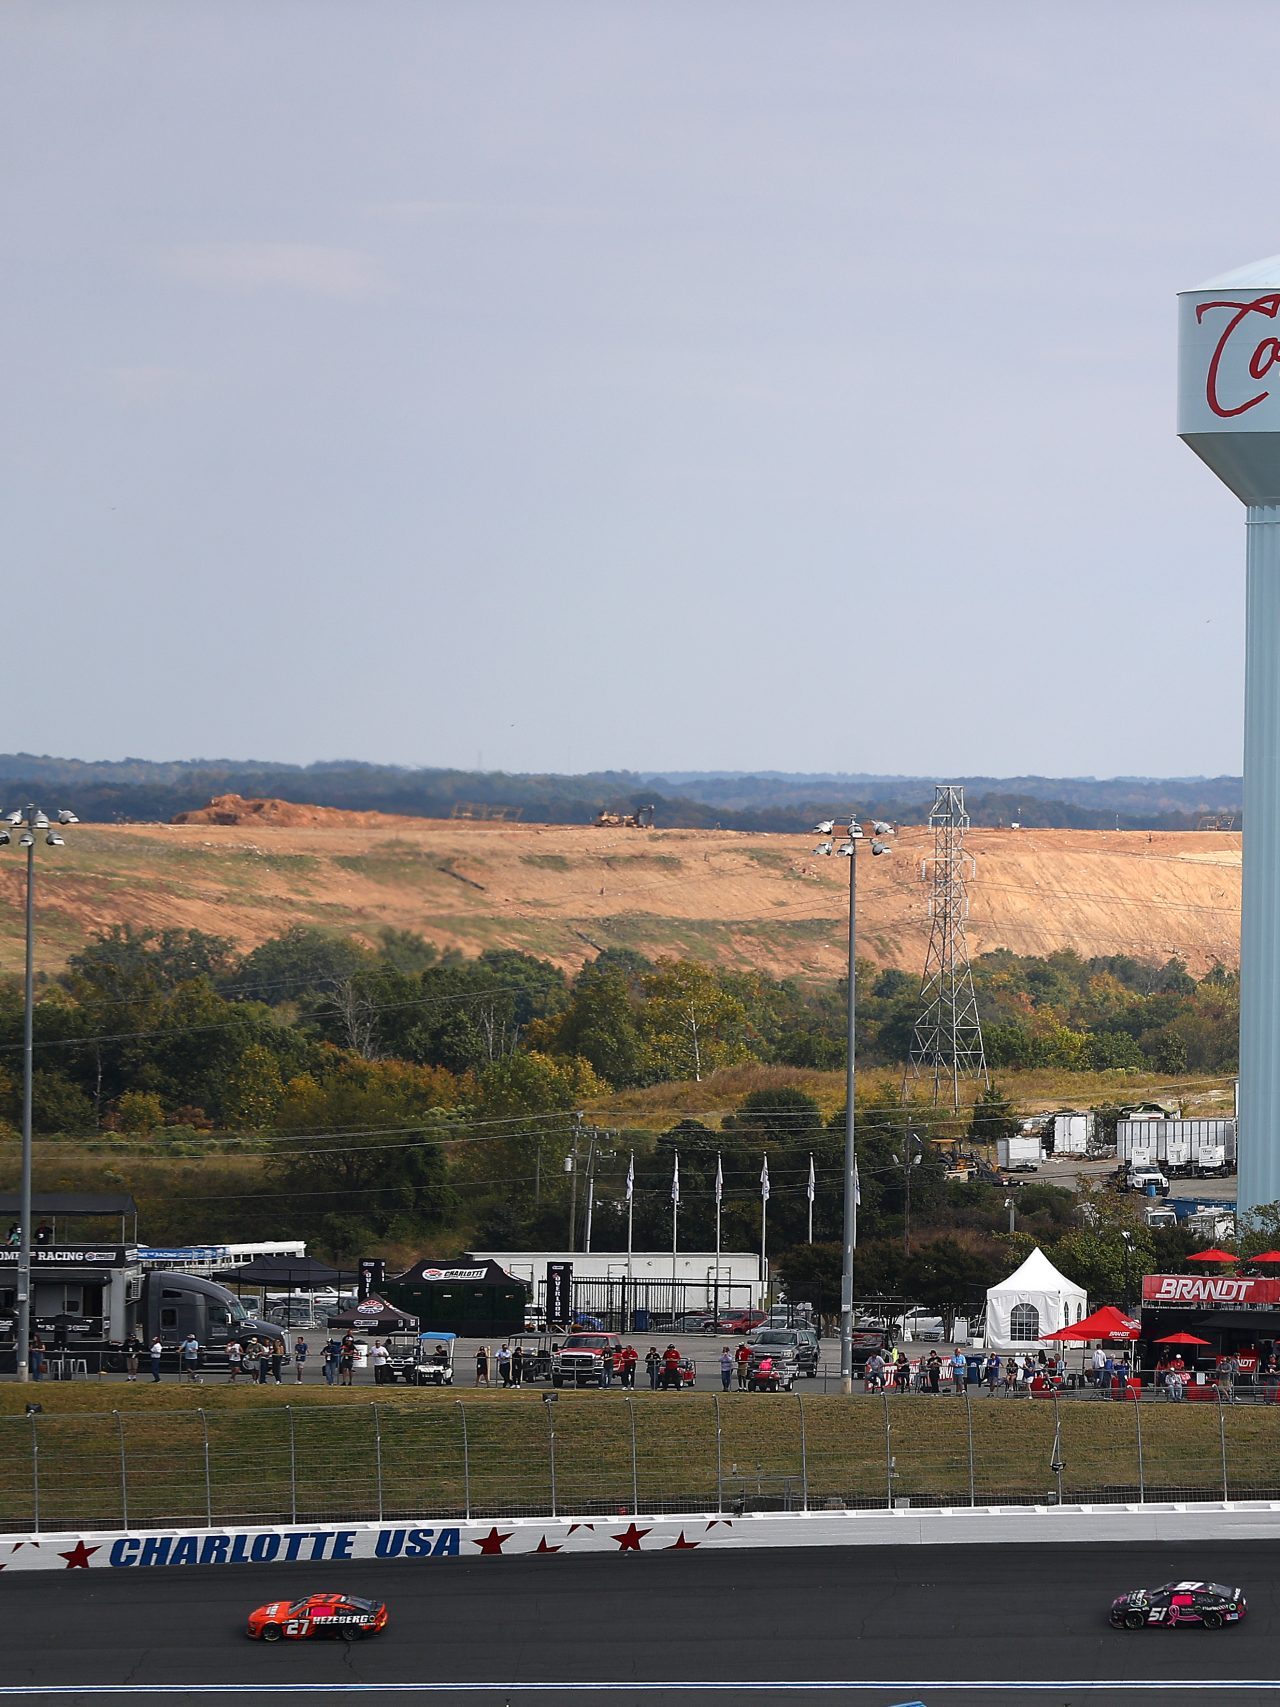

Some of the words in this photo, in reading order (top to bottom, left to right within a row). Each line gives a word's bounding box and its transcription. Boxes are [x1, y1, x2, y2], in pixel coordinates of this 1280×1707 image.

[37, 1251, 83, 1260] RACING
[1155, 1279, 1255, 1300] BRANDT
[109, 1530, 357, 1567] CHARLOTTE
[374, 1528, 460, 1558] USA
[1173, 1581, 1204, 1591] 51
[313, 1615, 368, 1625] HEZEBERG
[1148, 1608, 1167, 1621] 51
[286, 1619, 310, 1635] 27
